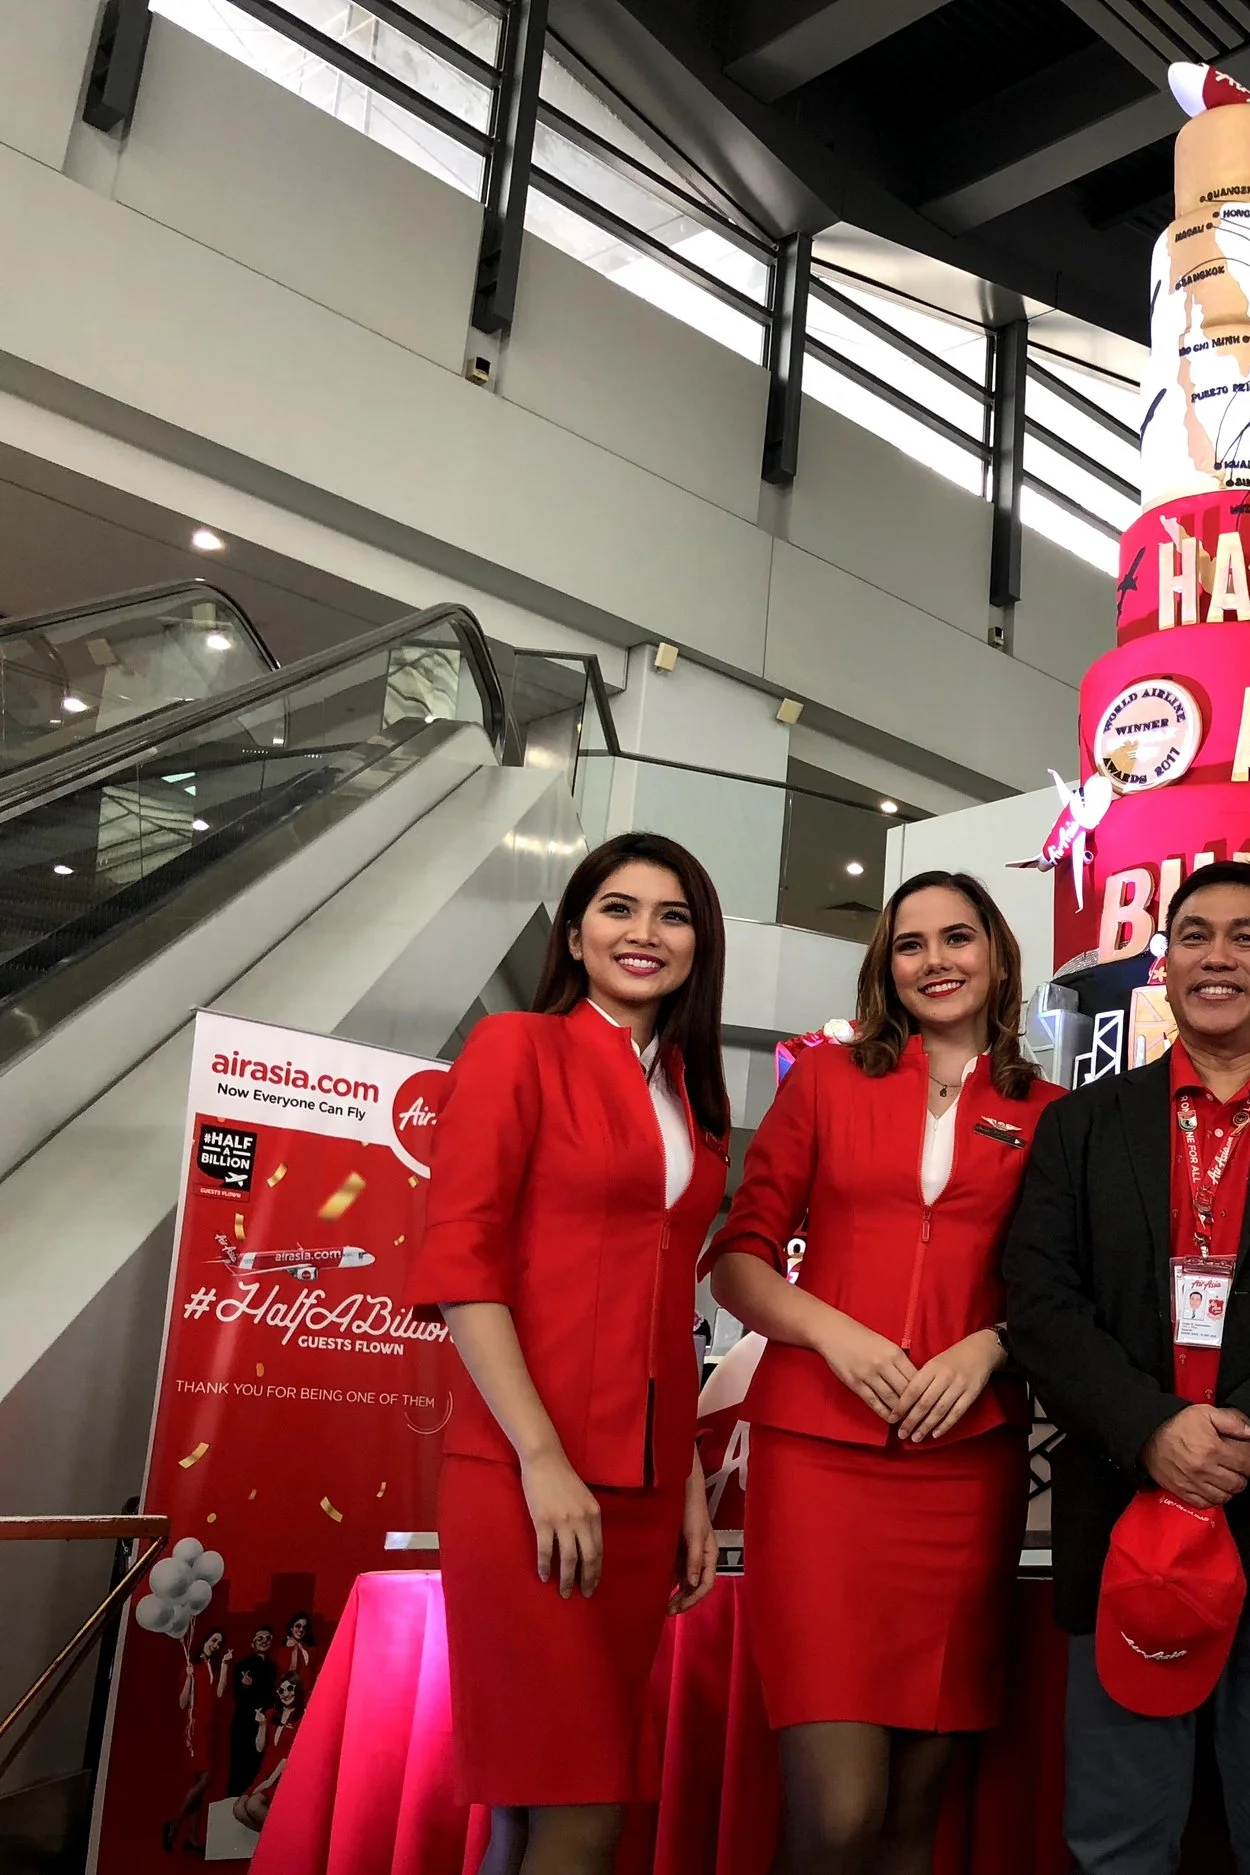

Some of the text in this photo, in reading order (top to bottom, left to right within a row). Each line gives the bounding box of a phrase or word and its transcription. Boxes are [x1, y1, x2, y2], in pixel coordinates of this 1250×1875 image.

[1103, 688, 1186, 734] WORLD AIRLINE
[1115, 718, 1169, 736] WINNER
[1103, 747, 1180, 784] AWARDS 2017
[211, 1050, 379, 1103] airasia.com
[217, 1083, 366, 1121] Now Everyone Can Fly
[204, 1131, 253, 1150] #HALF
[201, 1152, 250, 1170] BILLION
[223, 1147, 230, 1156] A
[1188, 1145, 1199, 1164] FOR
[1191, 1165, 1201, 1184] ALL
[275, 1249, 342, 1262] airasia.com
[298, 1335, 405, 1356] GUESTS FLOWN
[176, 1379, 435, 1409] THANK YOU FOR BEING ONE OF THEM
